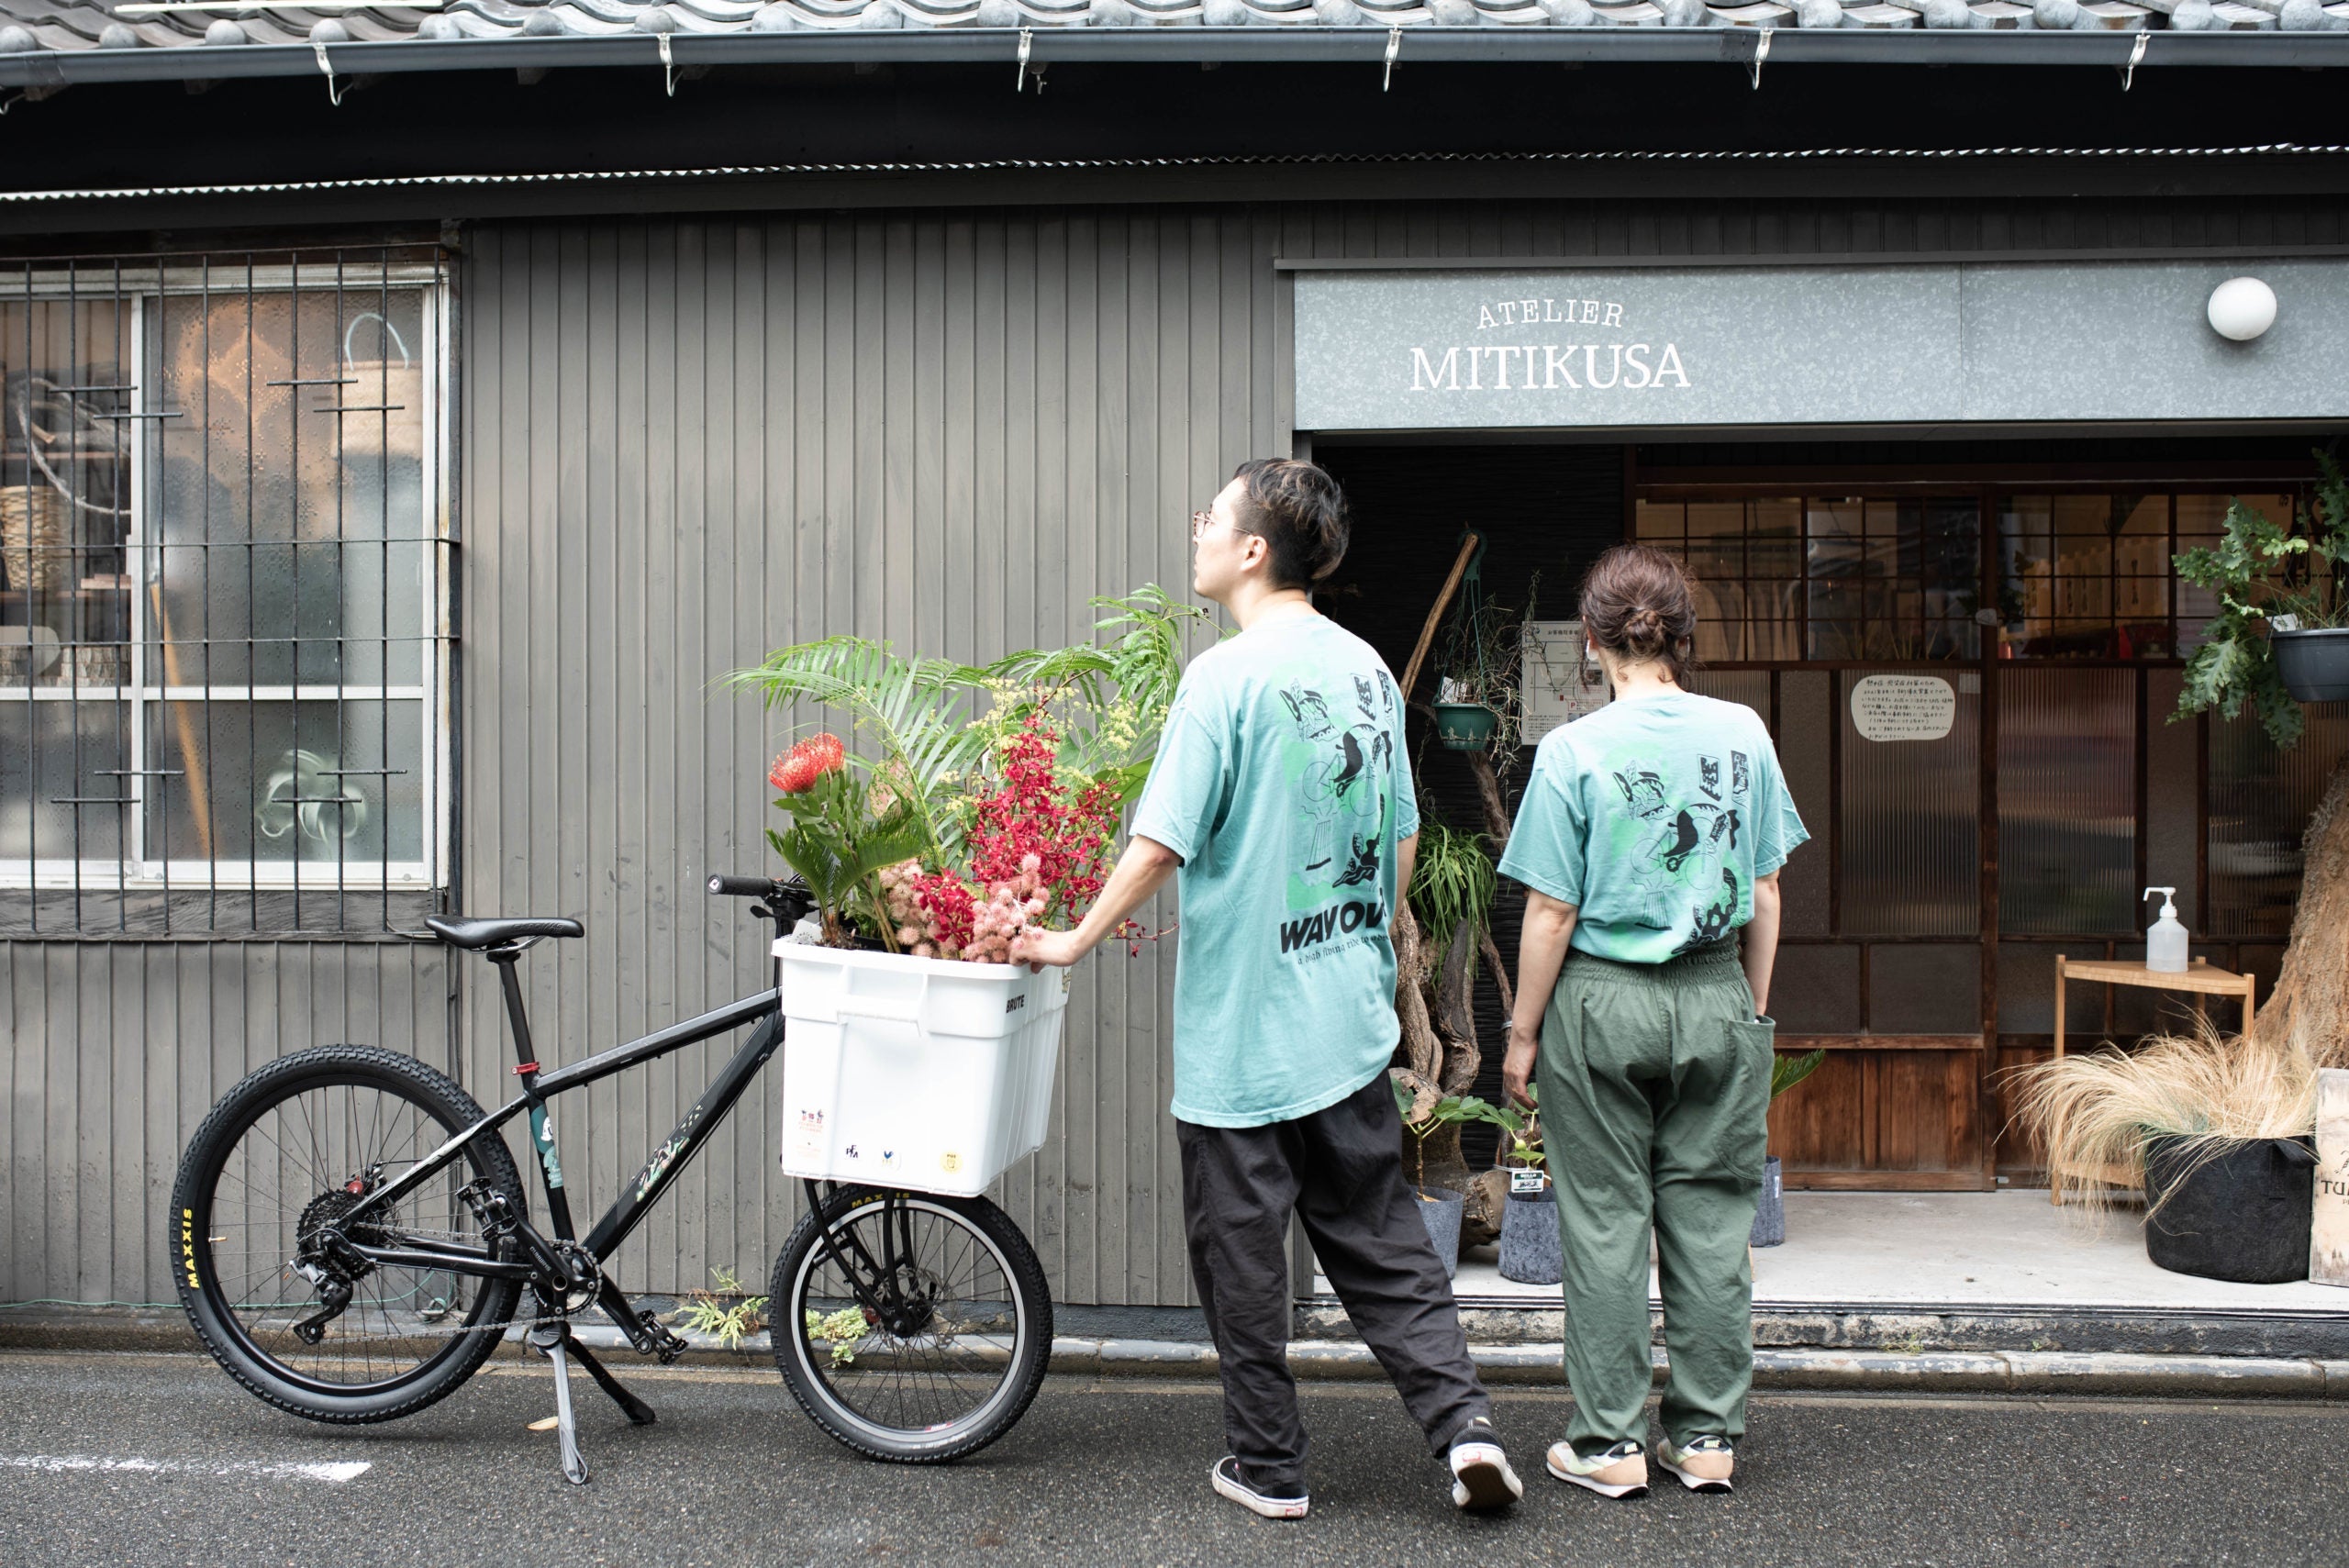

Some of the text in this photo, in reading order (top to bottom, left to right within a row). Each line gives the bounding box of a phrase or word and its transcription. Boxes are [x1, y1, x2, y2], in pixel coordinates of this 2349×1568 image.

[1475, 298, 1624, 329] ATELIER
[1409, 343, 1691, 392] MITIKUSA
[1280, 905, 1339, 954] WAY
[1006, 995, 1025, 1014] BRUTE
[852, 1193, 910, 1208] MAXIS
[2321, 1180, 2349, 1195] TU
[183, 1208, 200, 1288] MAXXIS
